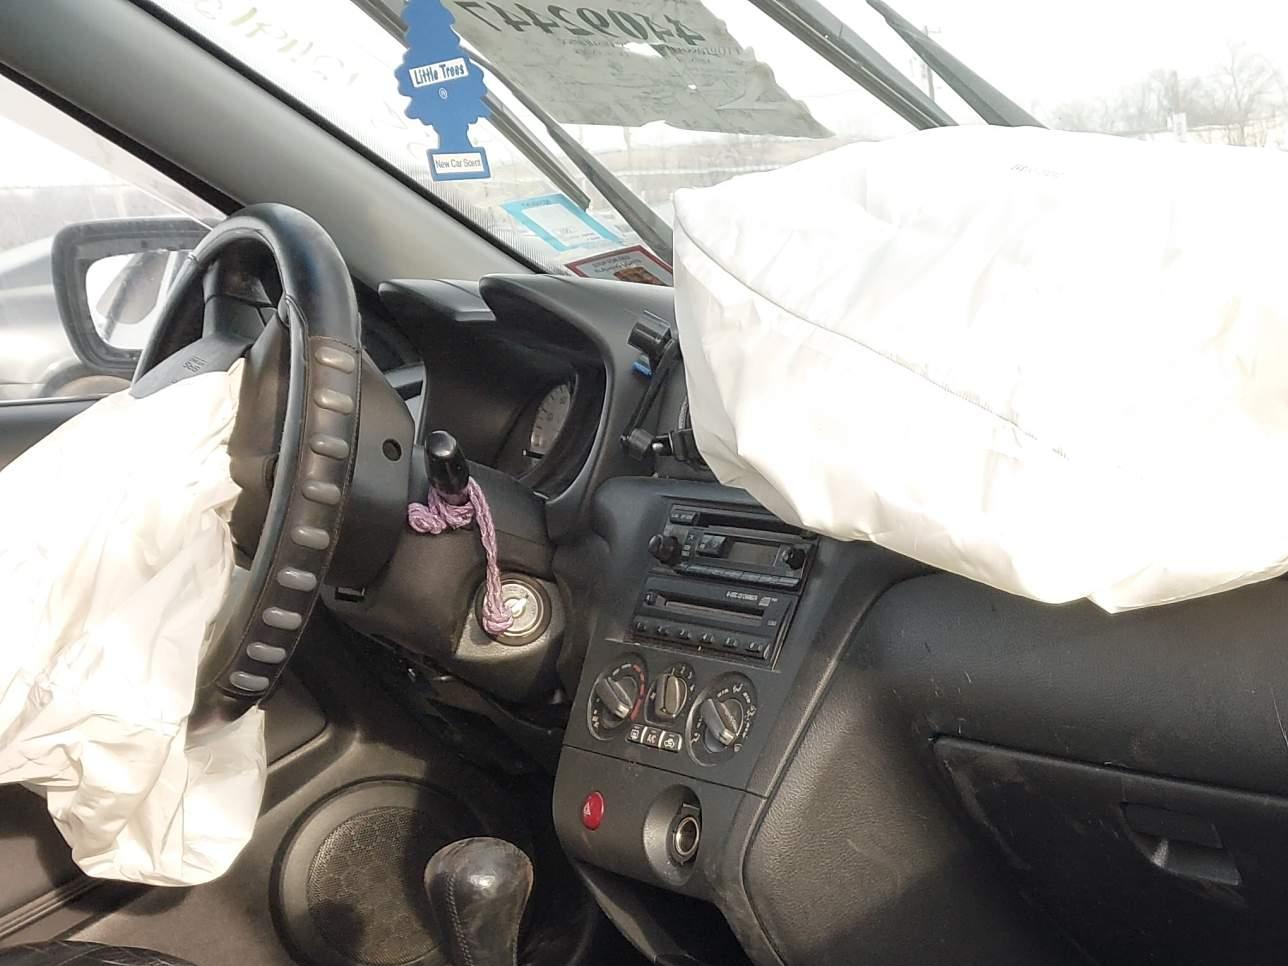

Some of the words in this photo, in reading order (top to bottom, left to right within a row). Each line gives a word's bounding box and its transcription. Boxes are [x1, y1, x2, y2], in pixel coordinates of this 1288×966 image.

[413, 66, 439, 85] Little
[439, 63, 465, 79] Trees
[450, 158, 462, 168] Car
